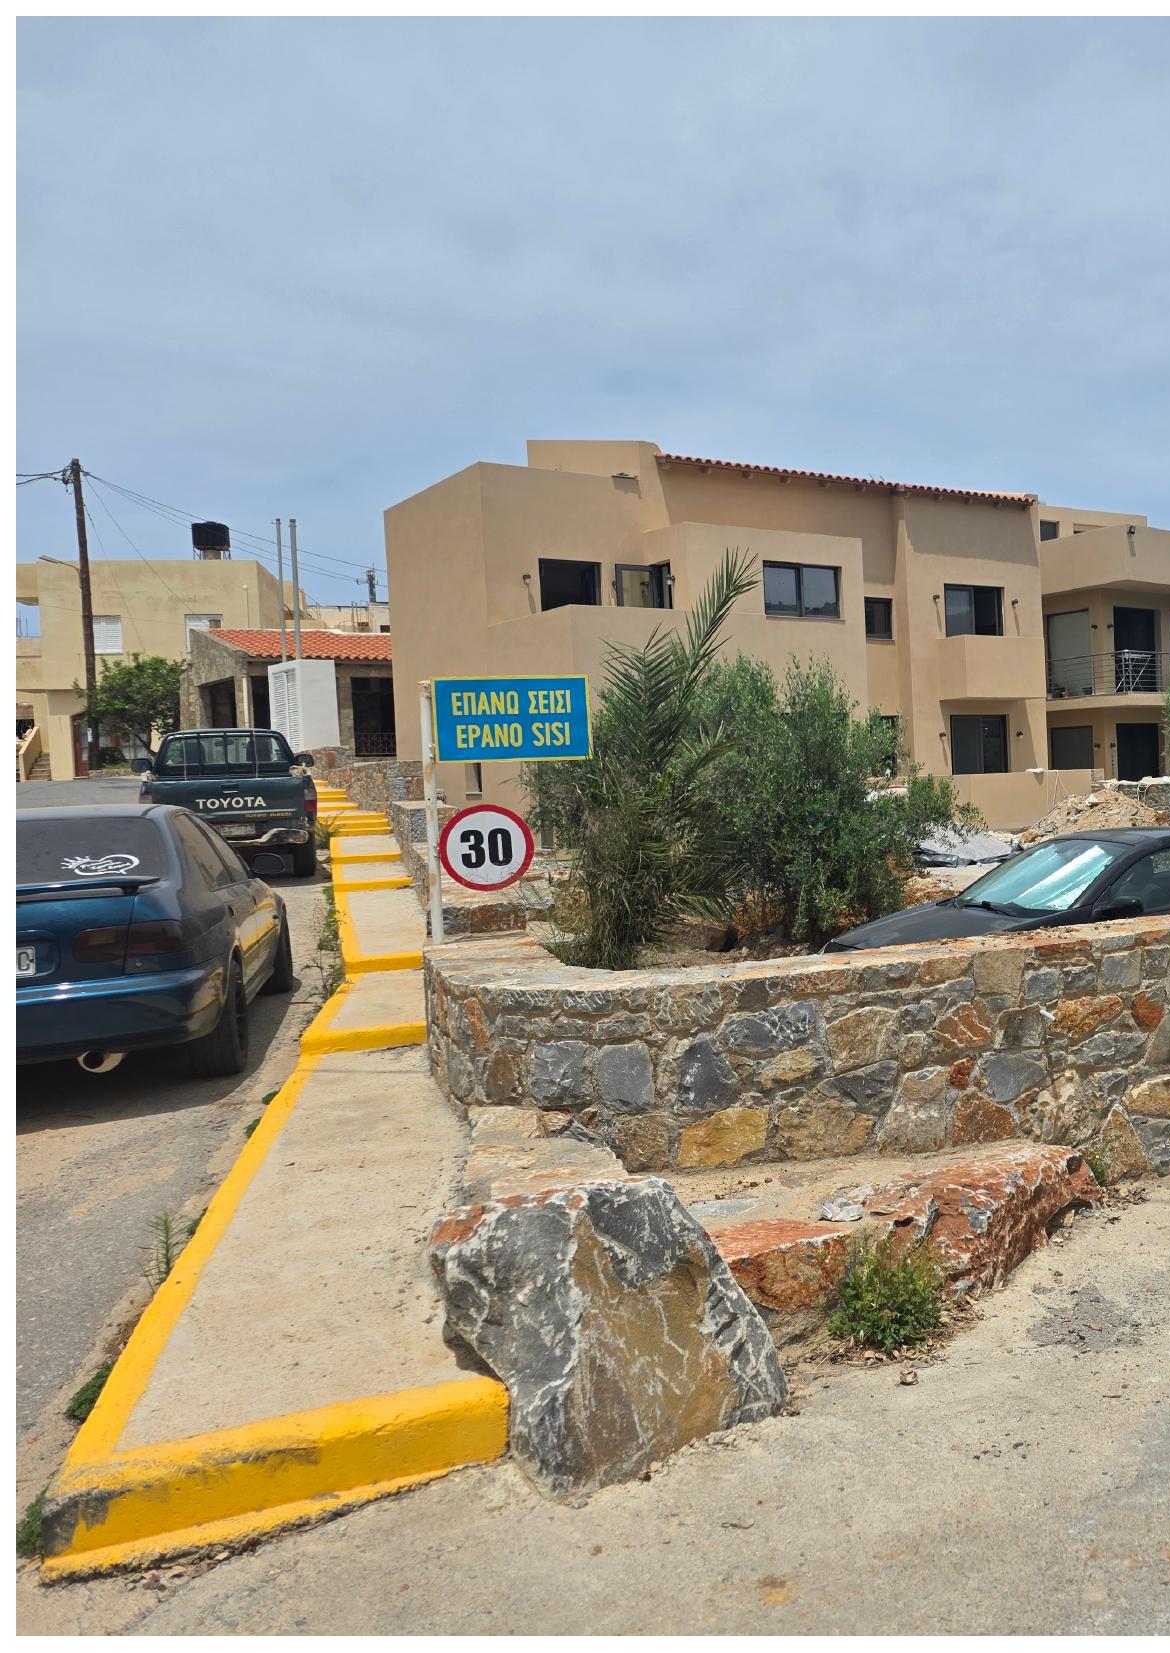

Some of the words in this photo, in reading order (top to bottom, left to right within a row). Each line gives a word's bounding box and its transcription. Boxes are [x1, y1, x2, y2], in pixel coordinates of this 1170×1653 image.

[452, 691, 519, 715] ΕΠΑΝΩ
[528, 690, 571, 714] ΣΕΙΣΙ
[456, 723, 523, 748] EPANO
[531, 722, 570, 746] SISI
[196, 796, 266, 809] TOYOTA
[460, 828, 513, 868] 30
